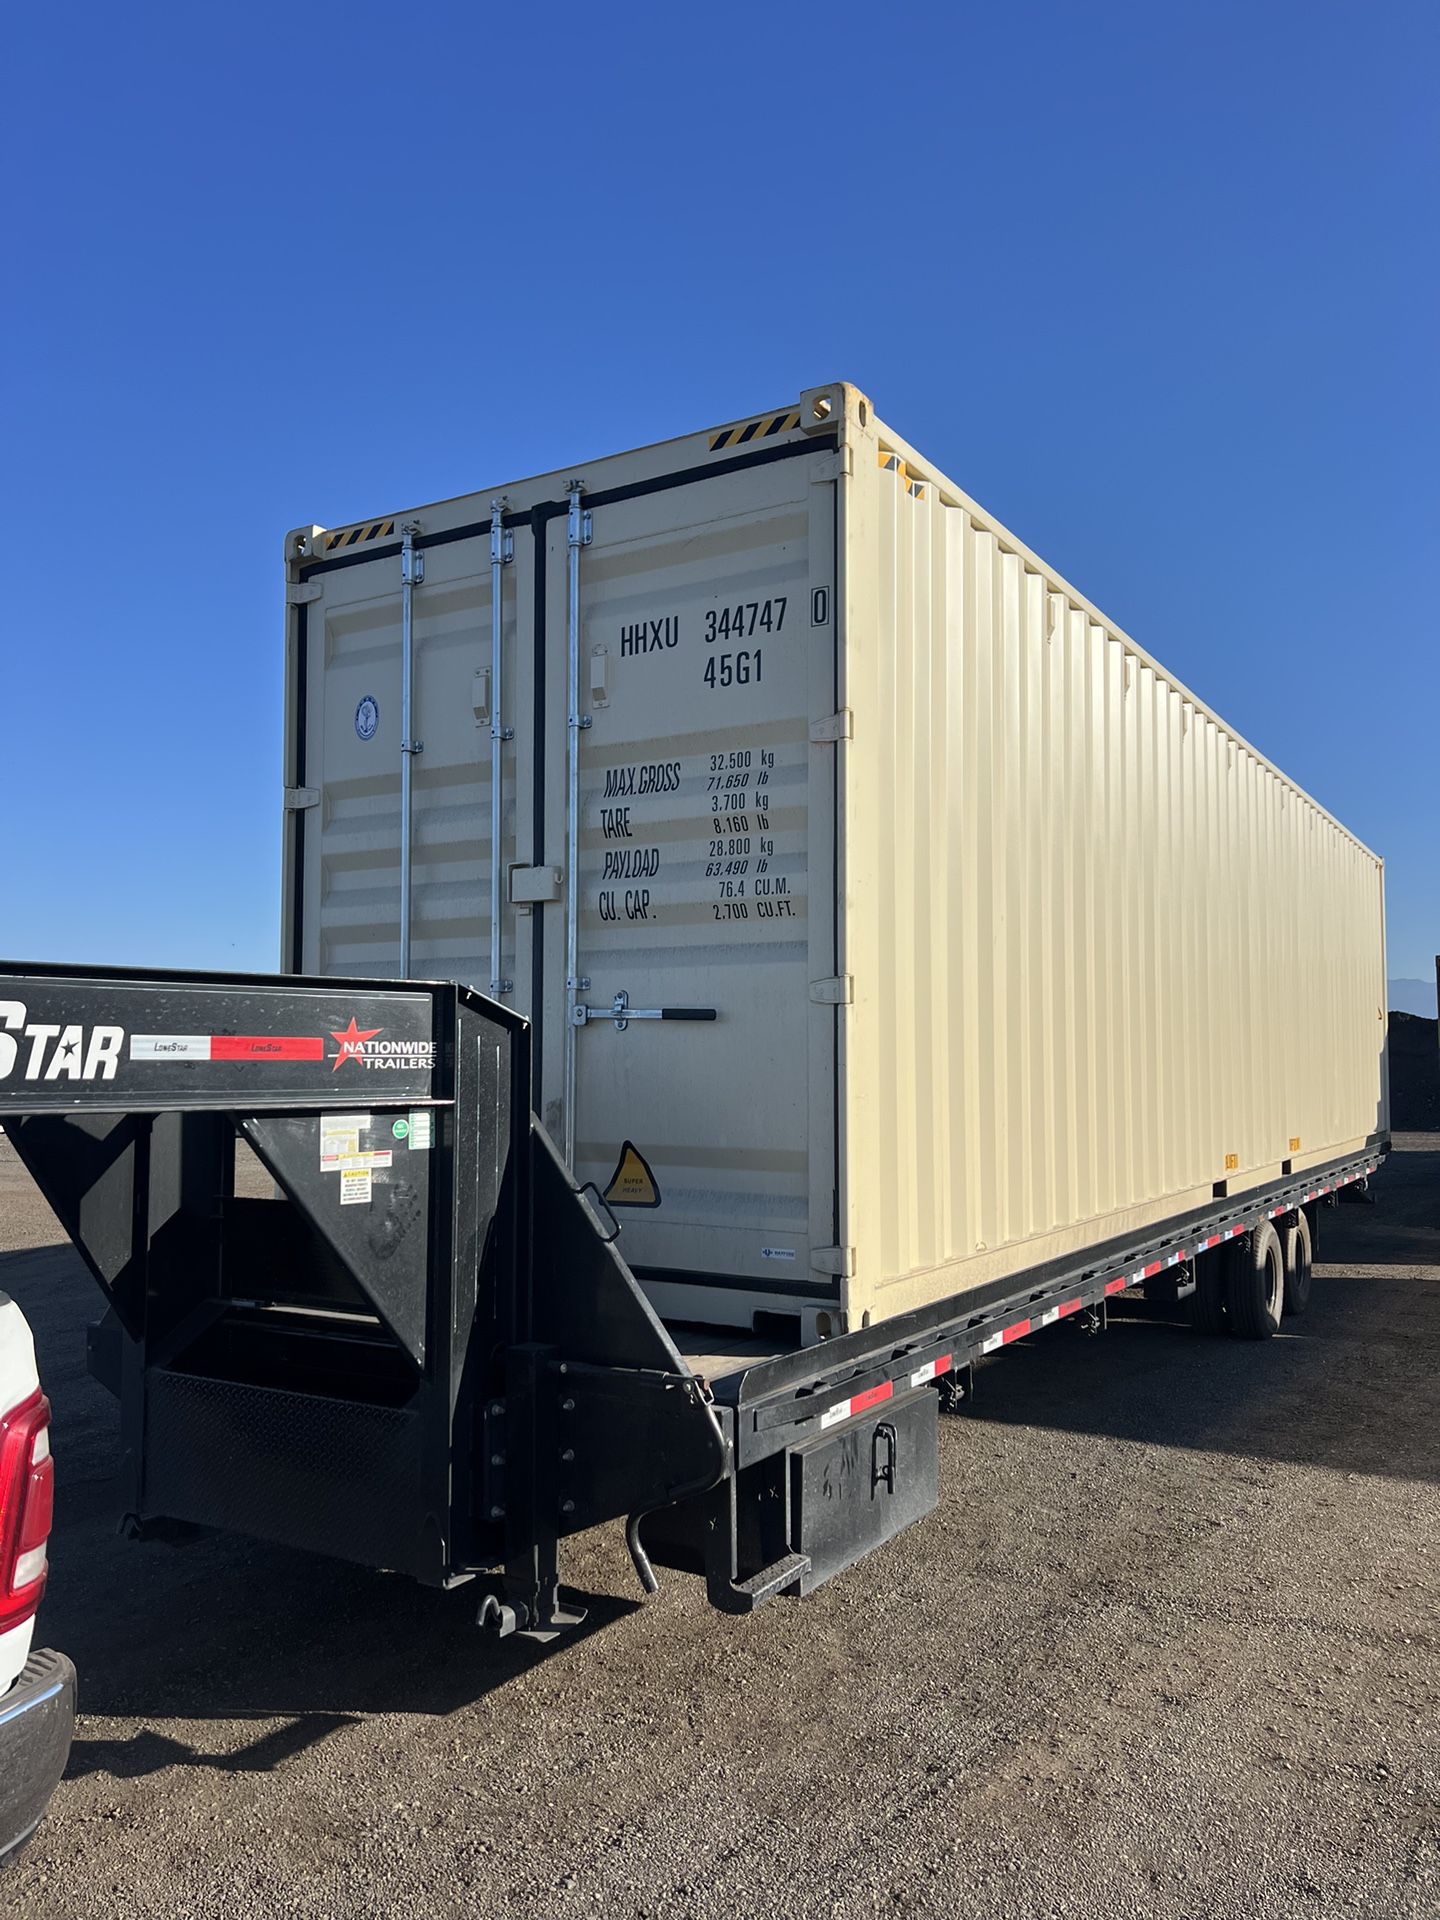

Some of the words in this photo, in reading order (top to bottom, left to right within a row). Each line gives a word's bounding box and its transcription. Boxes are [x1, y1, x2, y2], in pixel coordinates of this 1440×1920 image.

[620, 615, 679, 658] HHXU
[704, 596, 788, 644] 344747
[703, 648, 762, 689] 45G1
[603, 762, 681, 798] MAX.GROSS
[761, 748, 775, 769] kg
[756, 770, 769, 786] lb
[600, 806, 633, 840] TARE
[755, 791, 769, 812] kg
[756, 813, 770, 831] lb
[601, 848, 660, 881] PAYLOAD
[760, 836, 774, 857] kg
[756, 858, 769, 874] lb
[599, 890, 621, 922] CU.
[718, 879, 746, 899] 76.4
[754, 877, 792, 896] CU.M.
[756, 899, 796, 919] CU.FT.
[343, 1041, 437, 1054] NATIONWIDE
[363, 1058, 436, 1070] TRAILERS
